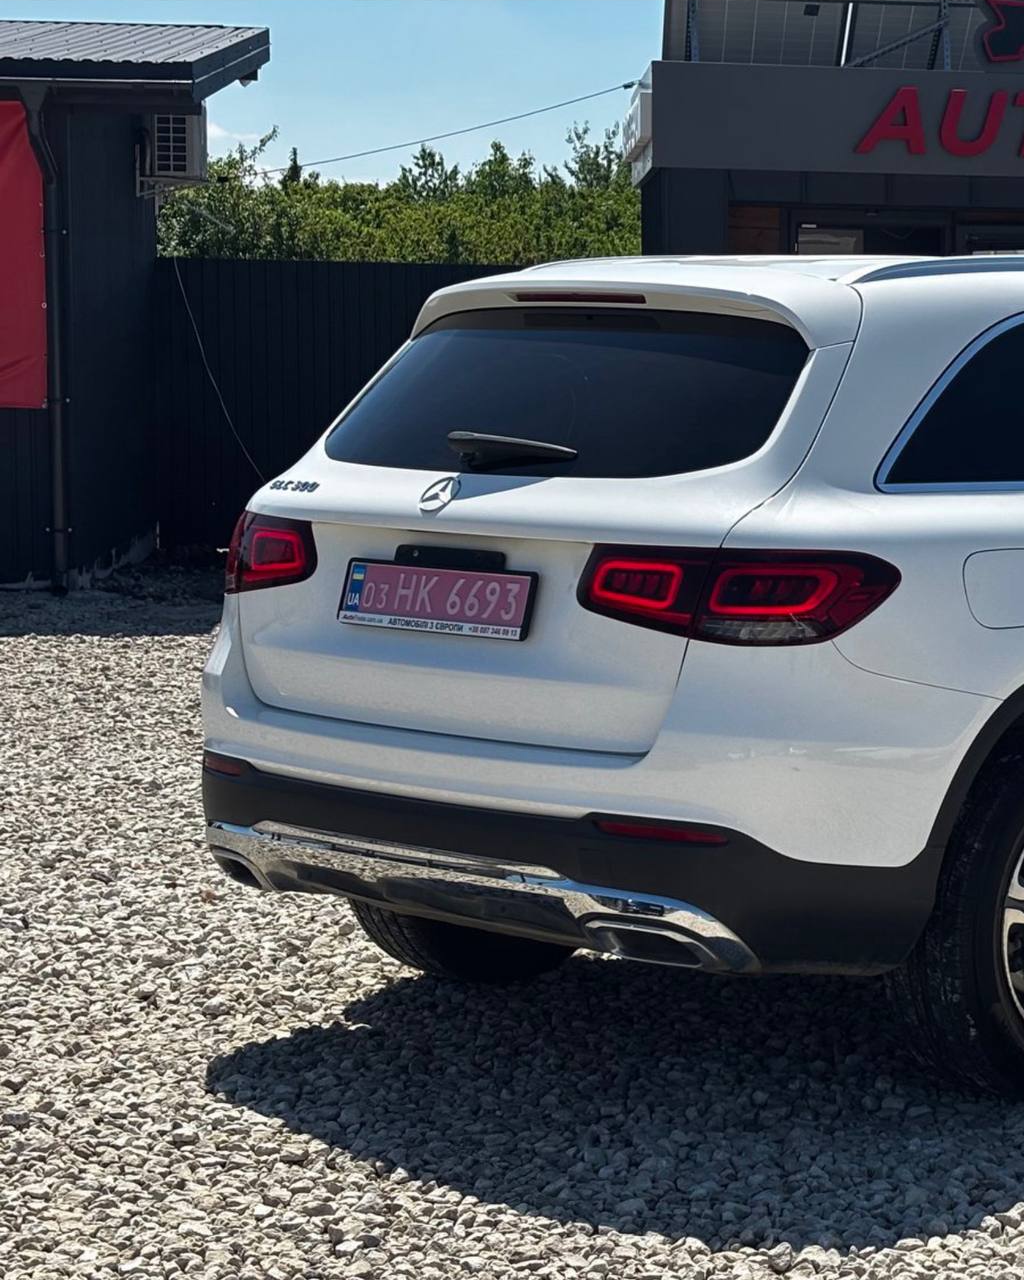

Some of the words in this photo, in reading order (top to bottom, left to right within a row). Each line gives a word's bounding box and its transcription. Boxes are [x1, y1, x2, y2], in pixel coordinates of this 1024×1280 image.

[347, 593, 360, 606] UA
[362, 582, 389, 609] 03
[446, 578, 520, 621] 6693
